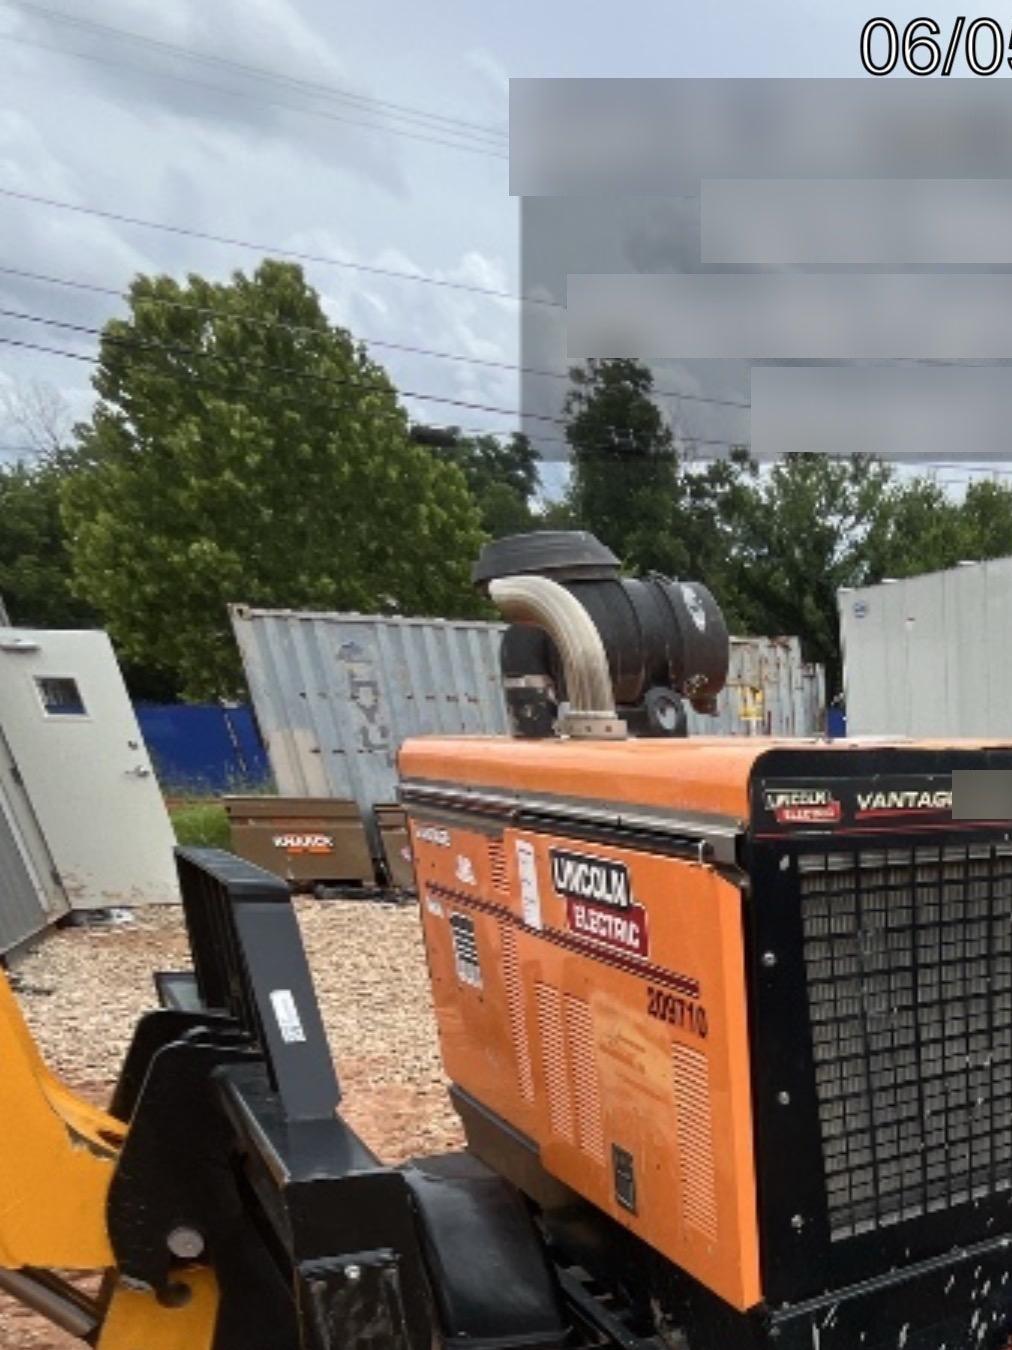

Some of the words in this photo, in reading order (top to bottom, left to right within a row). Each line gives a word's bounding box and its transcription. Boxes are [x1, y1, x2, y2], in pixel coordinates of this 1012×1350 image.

[553, 857, 628, 907] LINCOLN
[573, 903, 641, 949] ELECTRIC
[647, 986, 709, 1039] 209710
